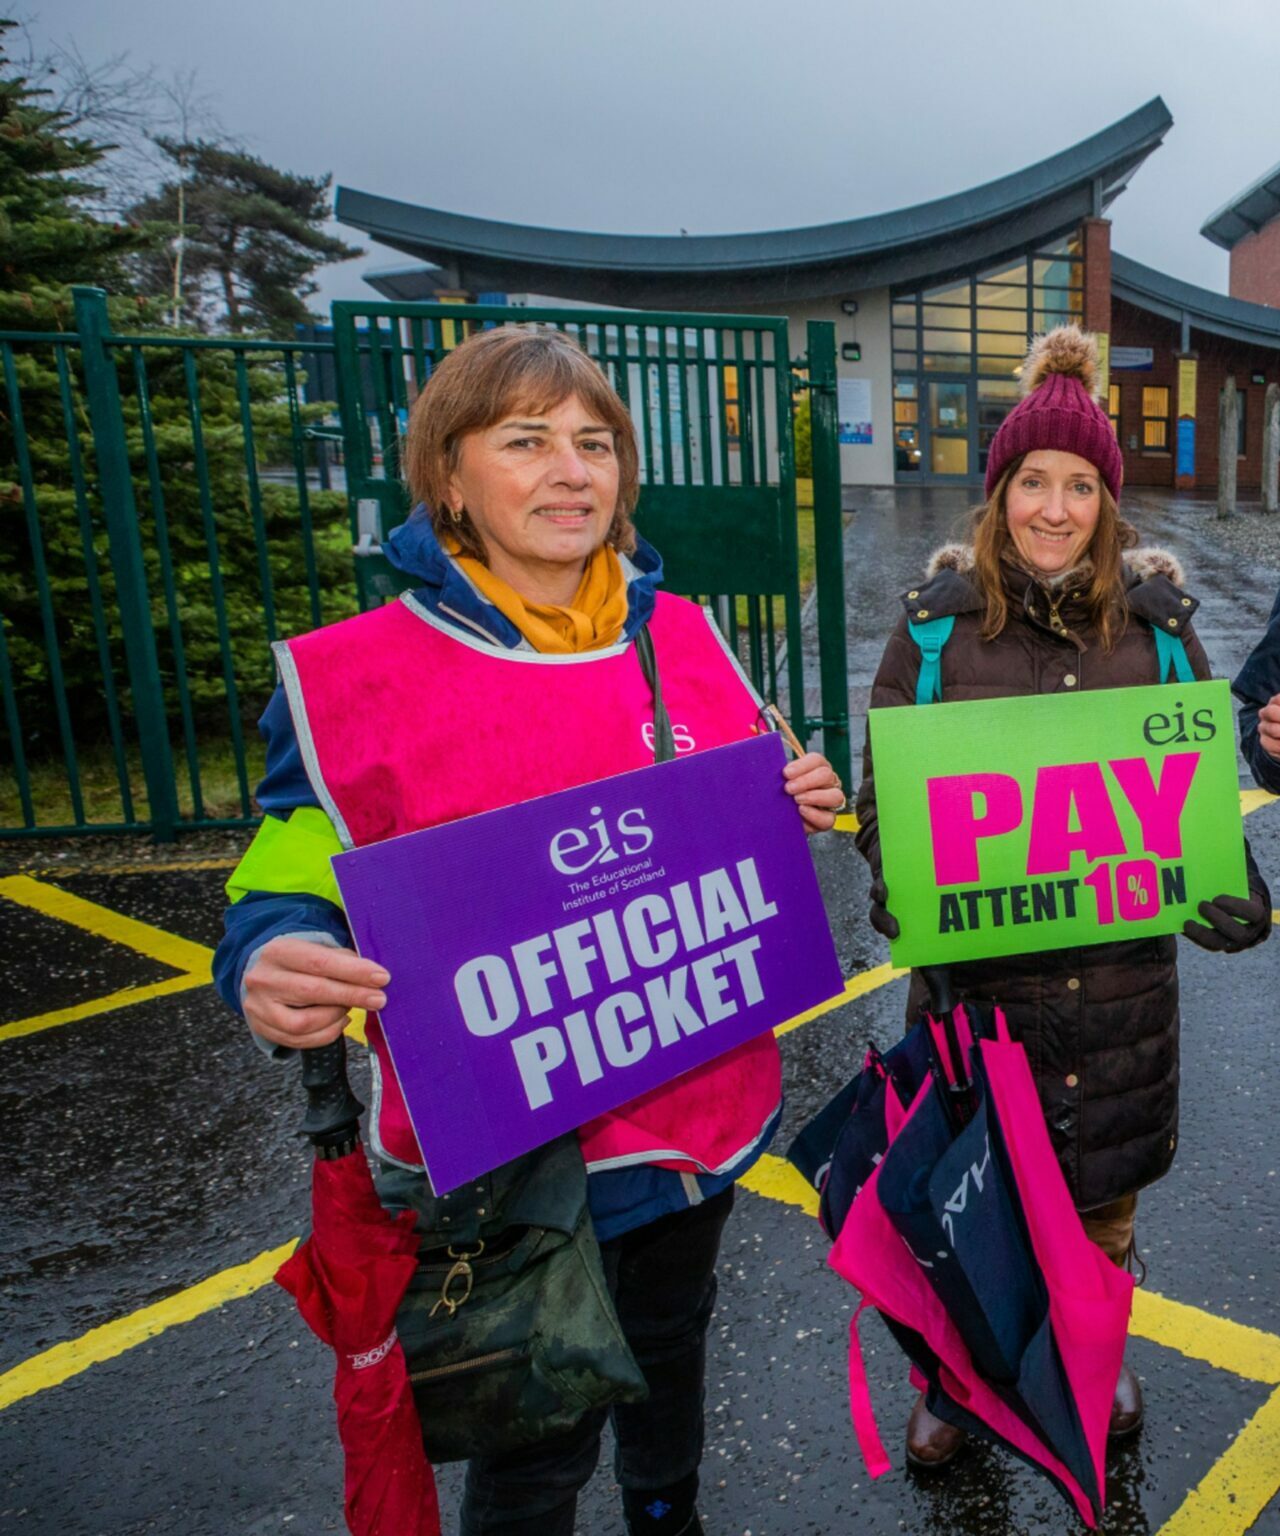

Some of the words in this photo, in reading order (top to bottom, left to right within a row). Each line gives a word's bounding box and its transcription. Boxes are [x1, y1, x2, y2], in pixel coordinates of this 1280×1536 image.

[641, 721, 696, 753] es
[1143, 701, 1217, 746] eis
[549, 805, 654, 876] eis
[926, 751, 1201, 887] PAY
[561, 889, 607, 912] Institute
[608, 882, 620, 895] of
[620, 866, 666, 891] Scotland
[568, 880, 591, 895] The
[591, 856, 653, 887] Educational
[453, 857, 778, 1038] OFFICIAL
[510, 934, 766, 1112] PICKET
